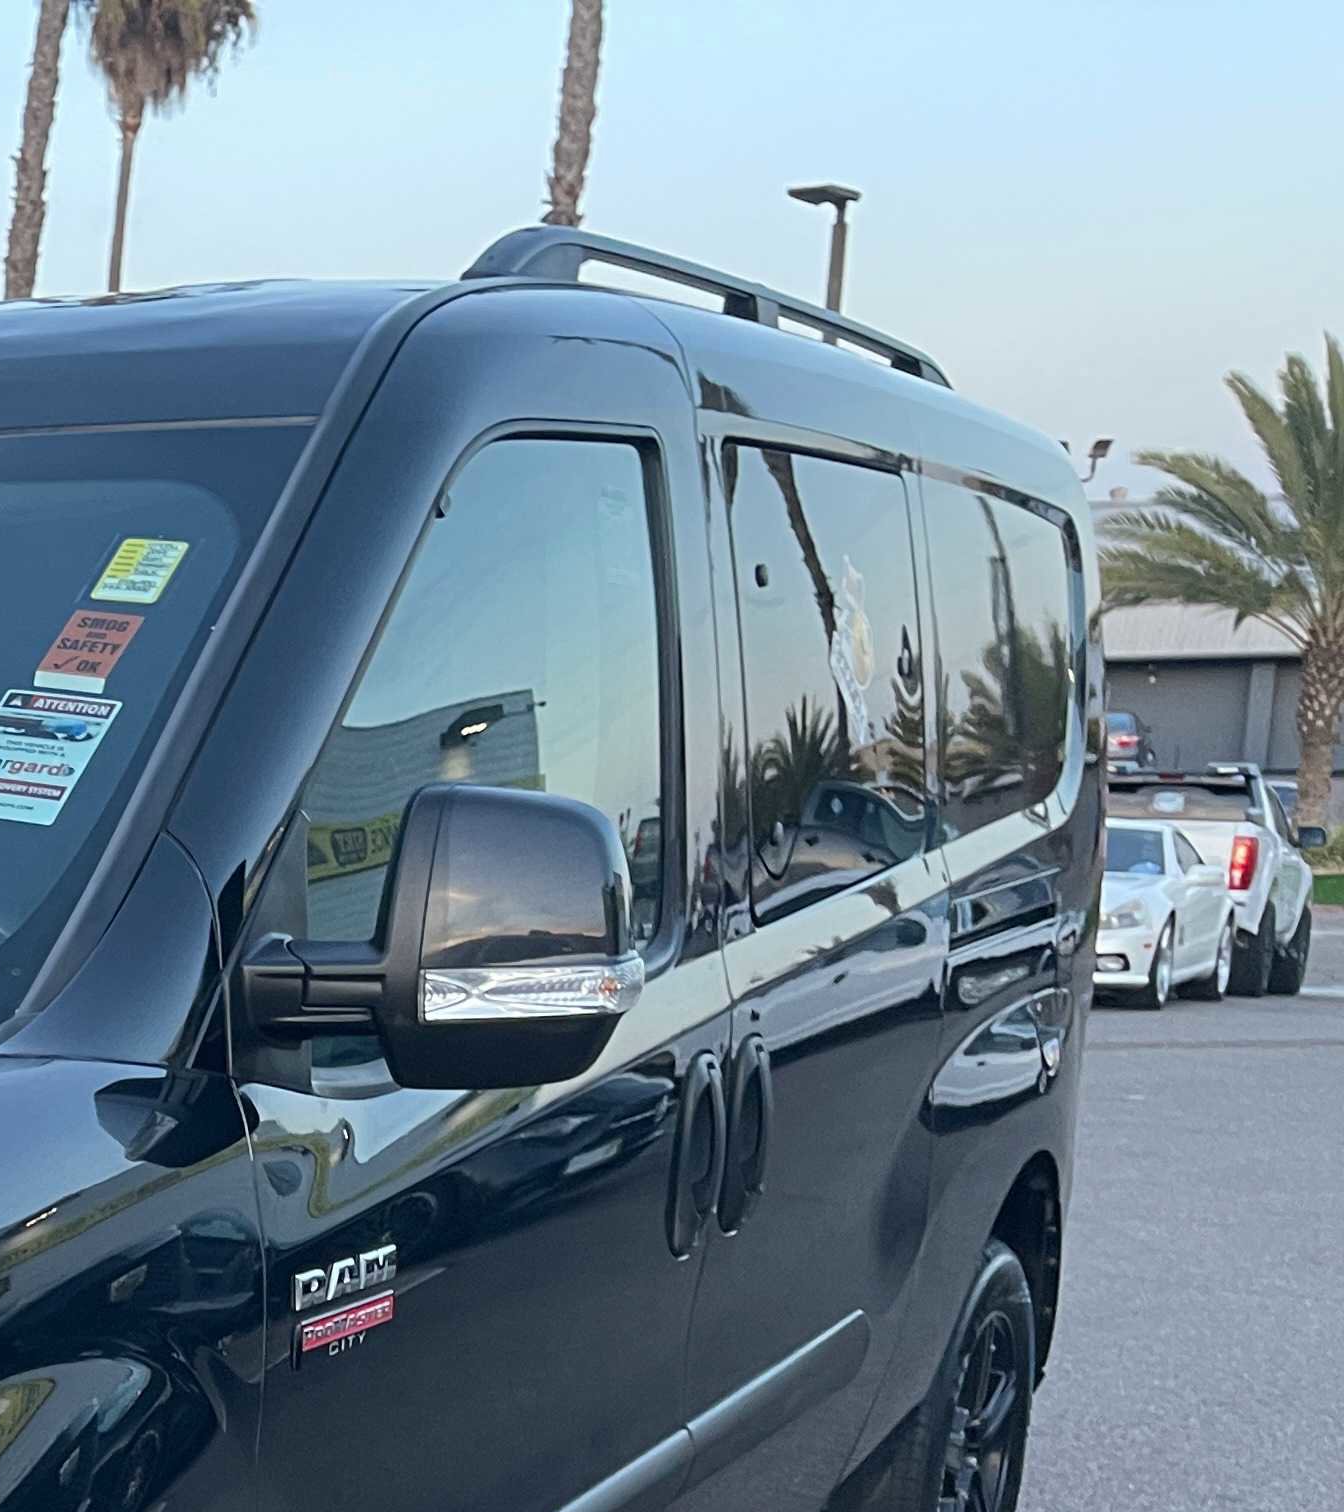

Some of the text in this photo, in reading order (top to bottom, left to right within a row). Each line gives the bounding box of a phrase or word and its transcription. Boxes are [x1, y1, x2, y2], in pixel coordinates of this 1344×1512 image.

[77, 616, 131, 632] SMOG
[56, 637, 123, 656] SAFETY
[75, 659, 103, 674] OK
[32, 697, 112, 717] ATTENTION
[28, 784, 62, 798] SYSTEM
[294, 1244, 398, 1312] RAM
[328, 1331, 367, 1356] CITY
